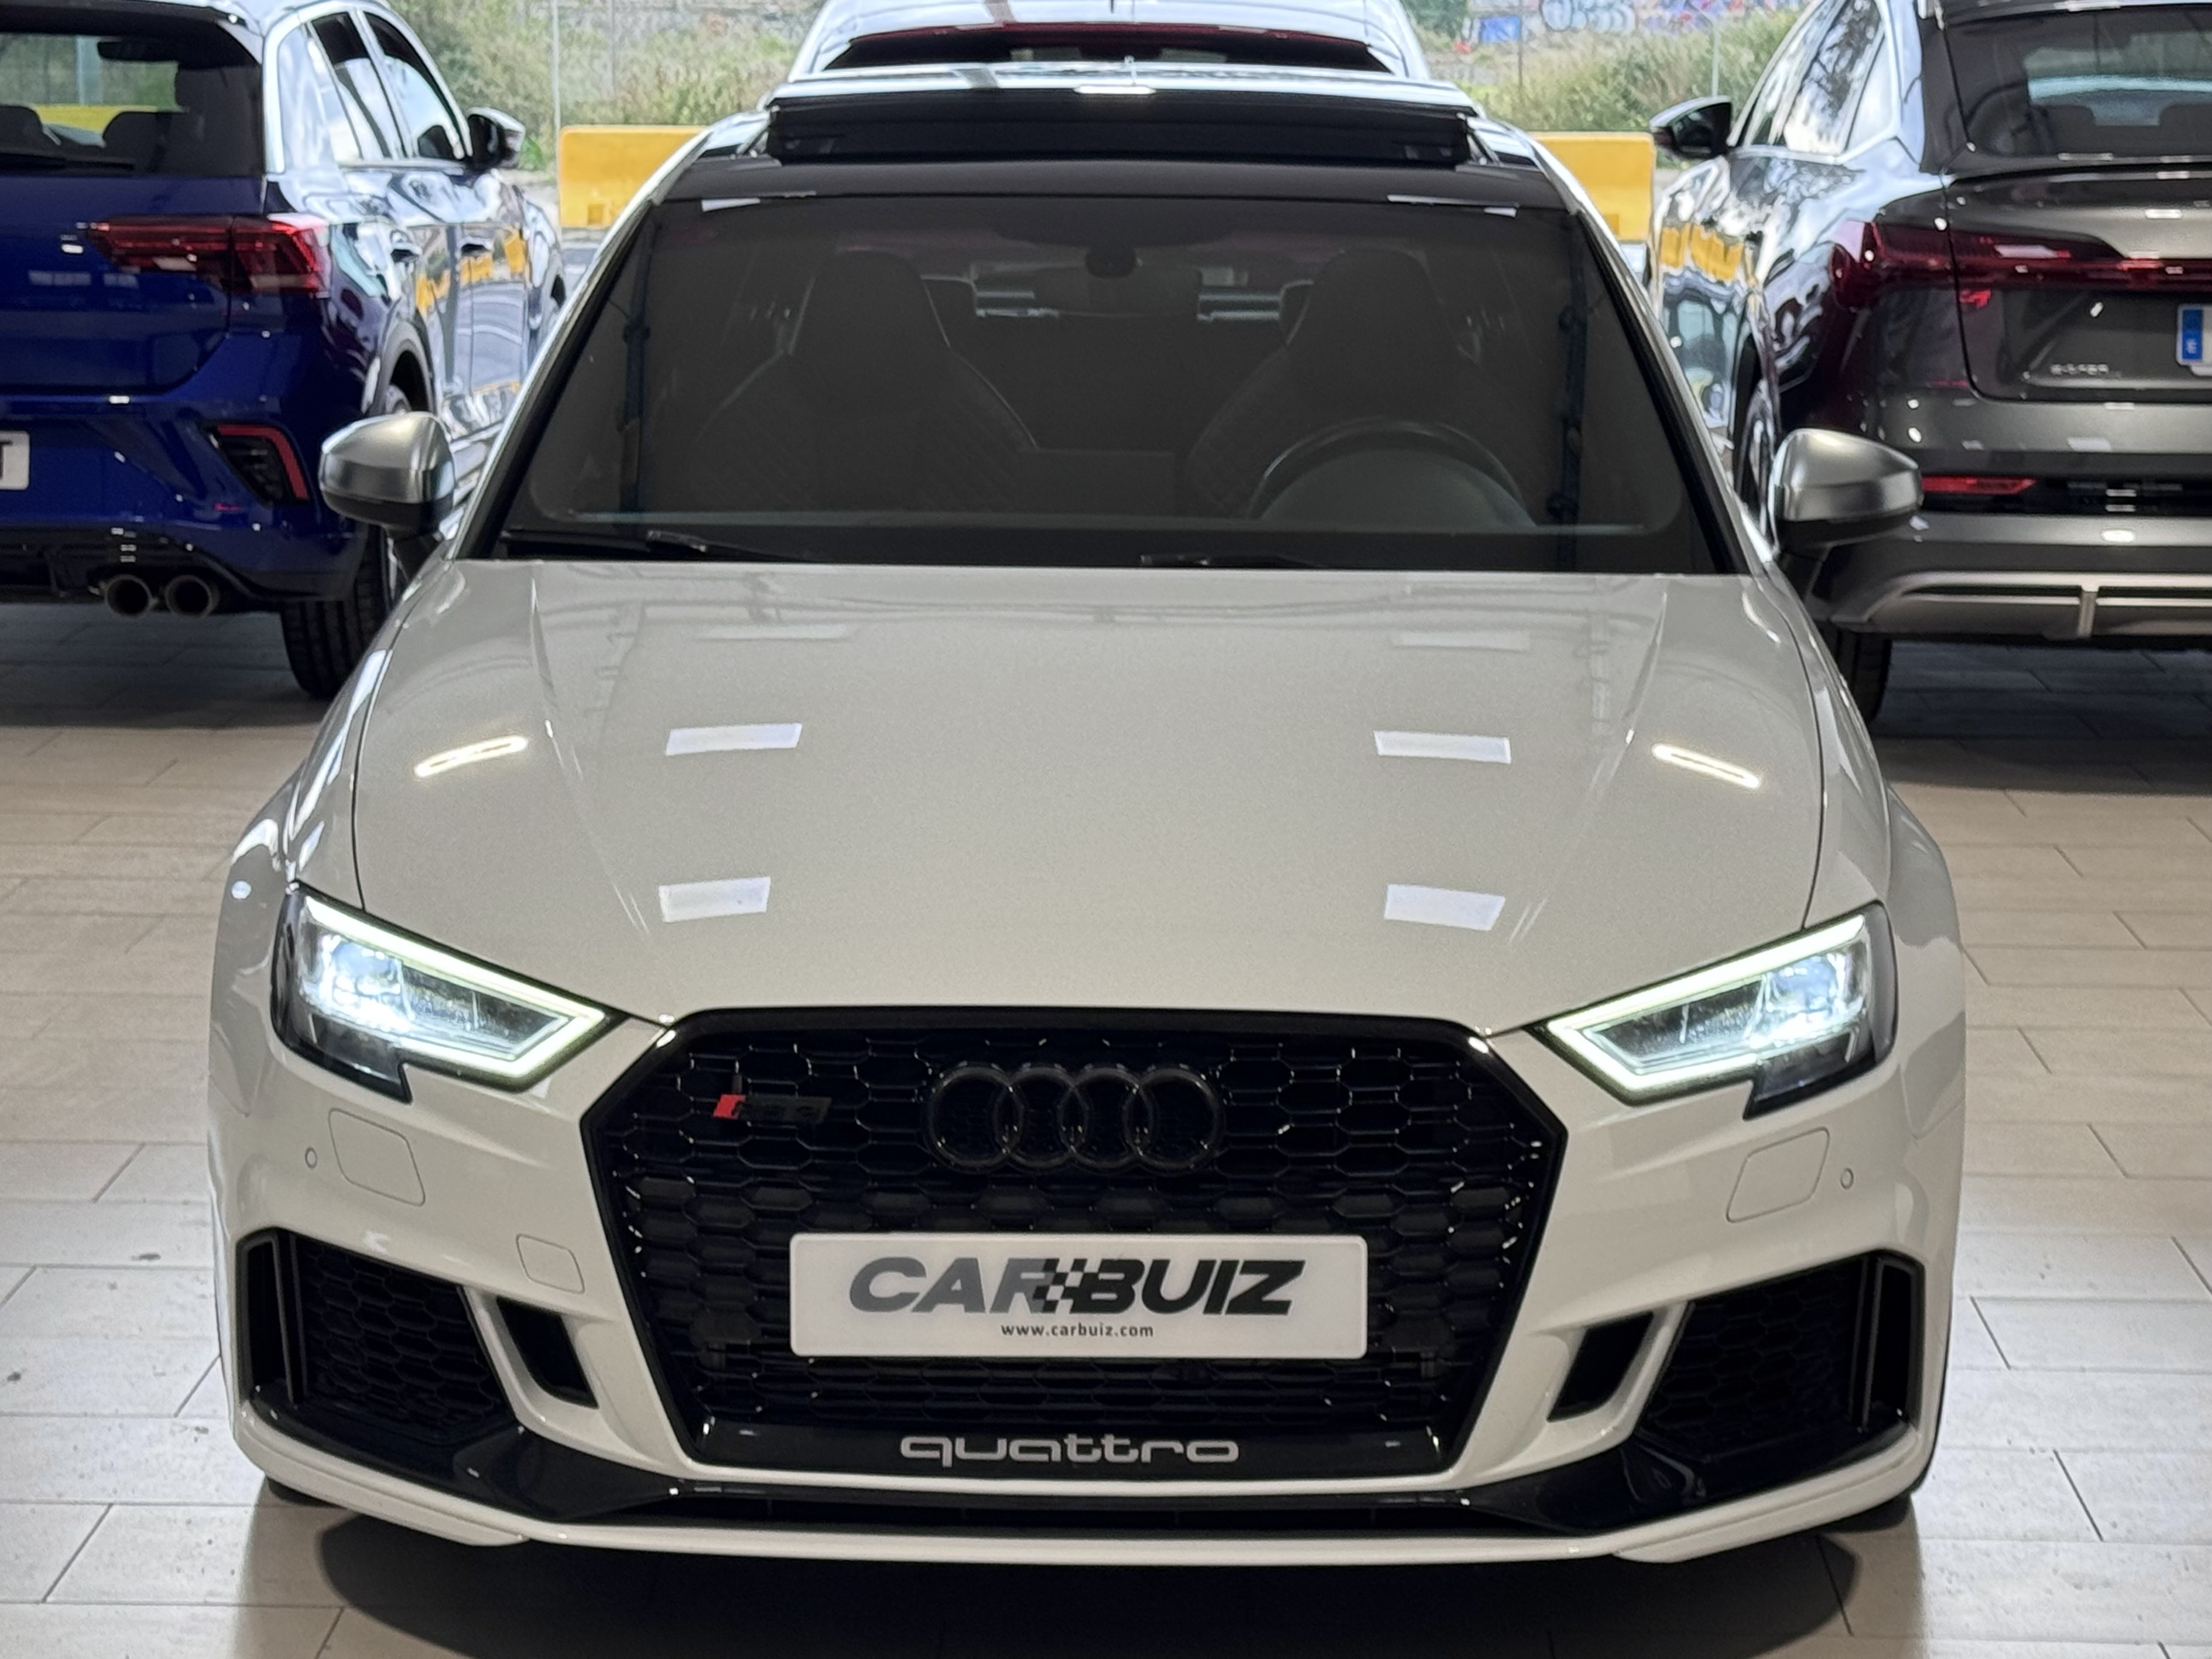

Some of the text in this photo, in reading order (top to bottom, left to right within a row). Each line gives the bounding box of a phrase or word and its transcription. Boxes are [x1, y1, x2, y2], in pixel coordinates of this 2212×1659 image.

[850, 1256, 1306, 1316] CARBUIZ
[1001, 1322, 1154, 1337] www.carbuiz.com
[901, 1434, 1238, 1467] quattro
